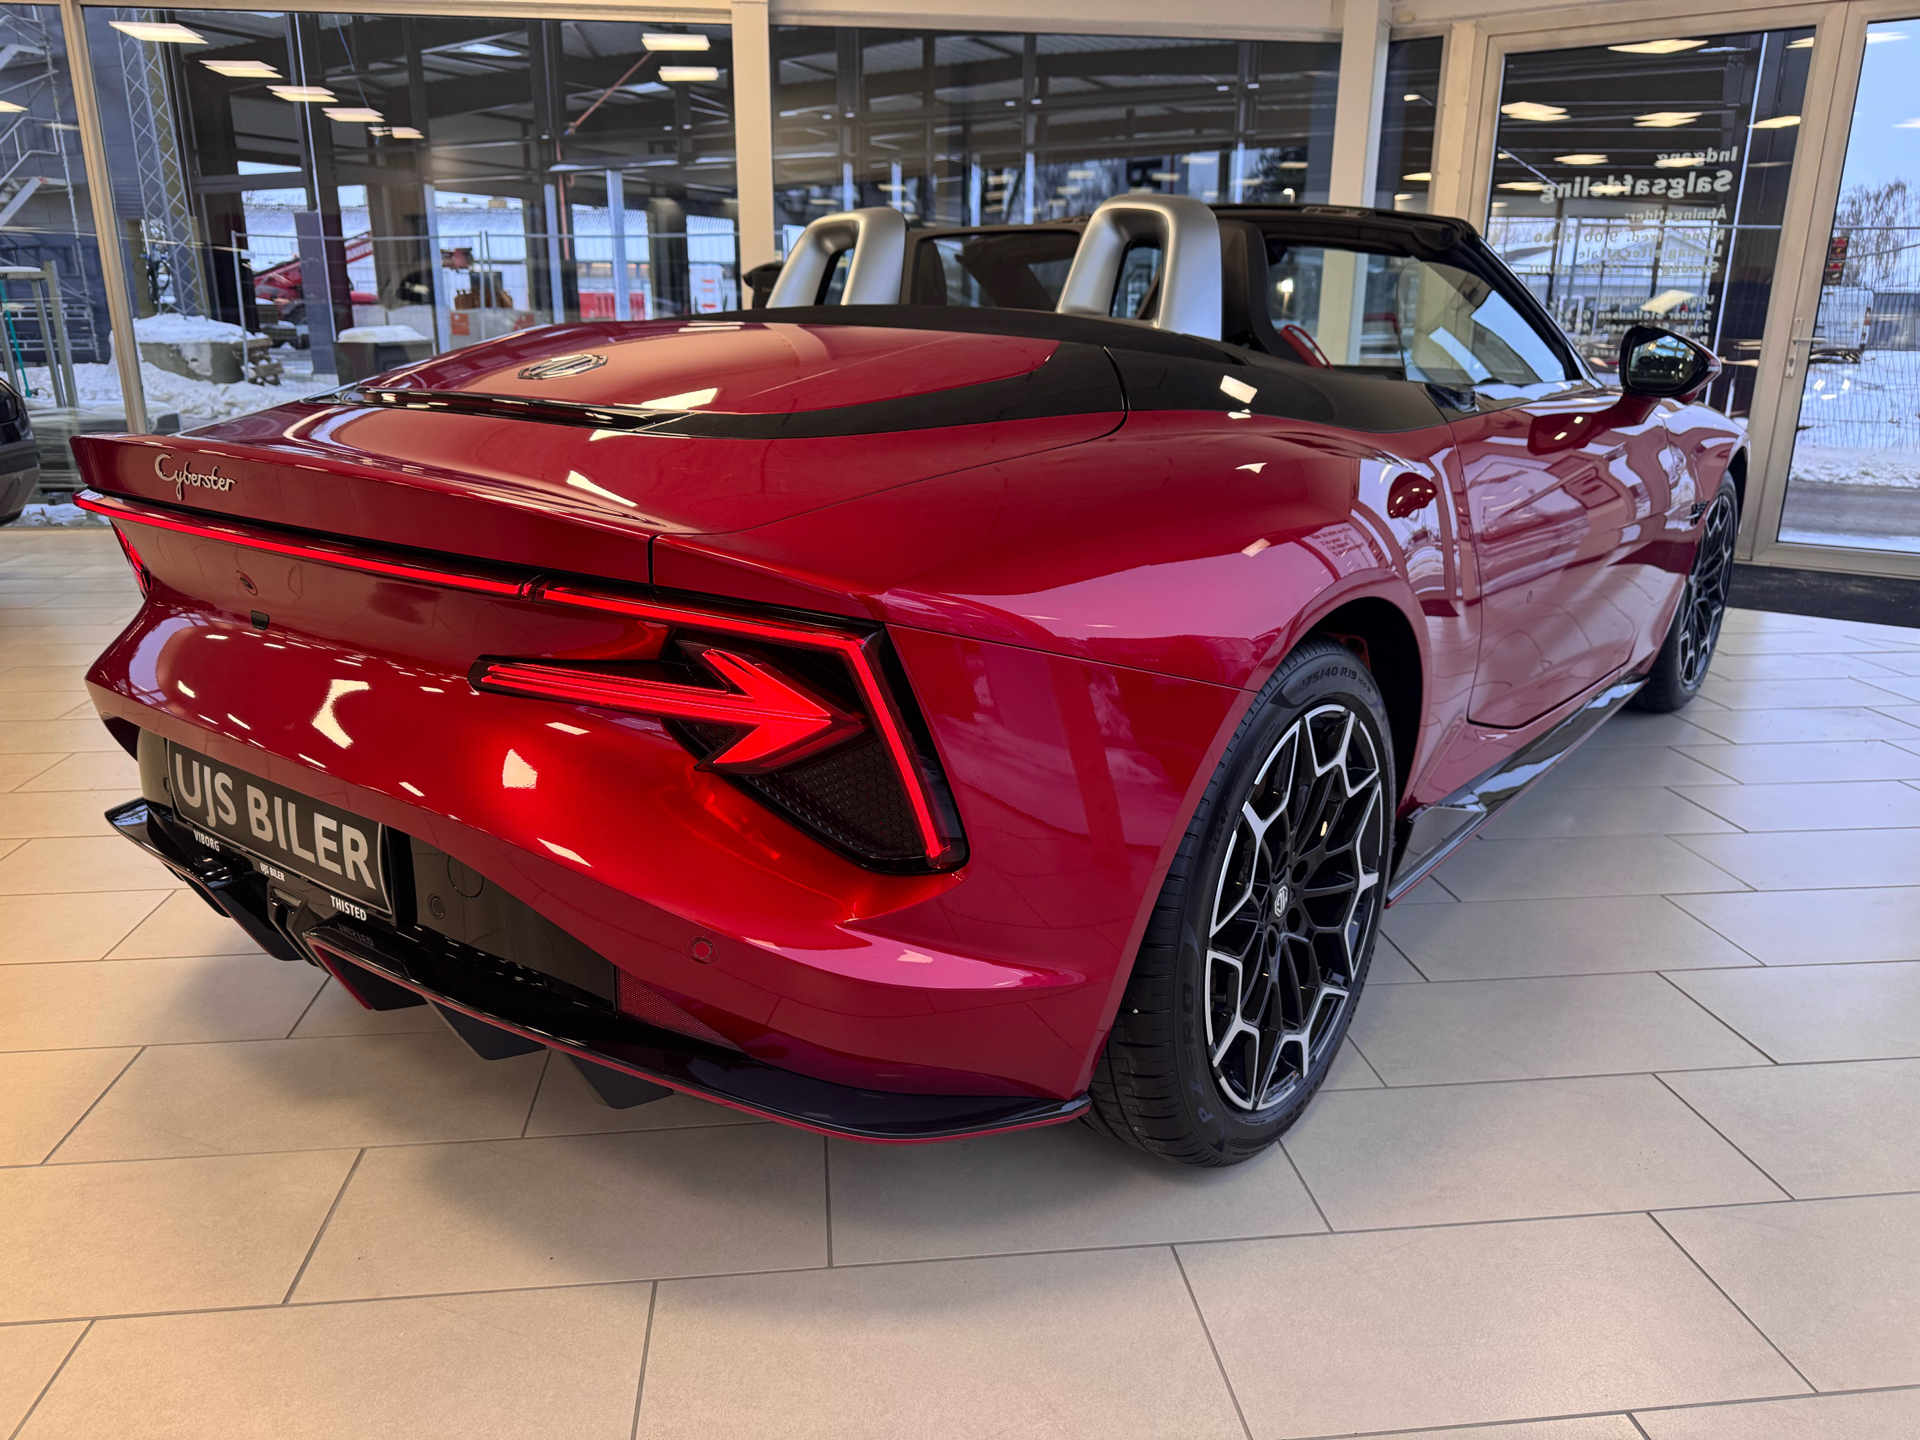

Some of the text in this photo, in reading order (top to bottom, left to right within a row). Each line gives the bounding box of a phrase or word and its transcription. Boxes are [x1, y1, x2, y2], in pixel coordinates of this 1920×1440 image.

[154, 454, 237, 501] Cyberster
[175, 753, 377, 890] UJS BILER
[193, 830, 220, 852] VIBORG
[269, 868, 285, 882] BILER
[330, 895, 367, 921] THISTED
